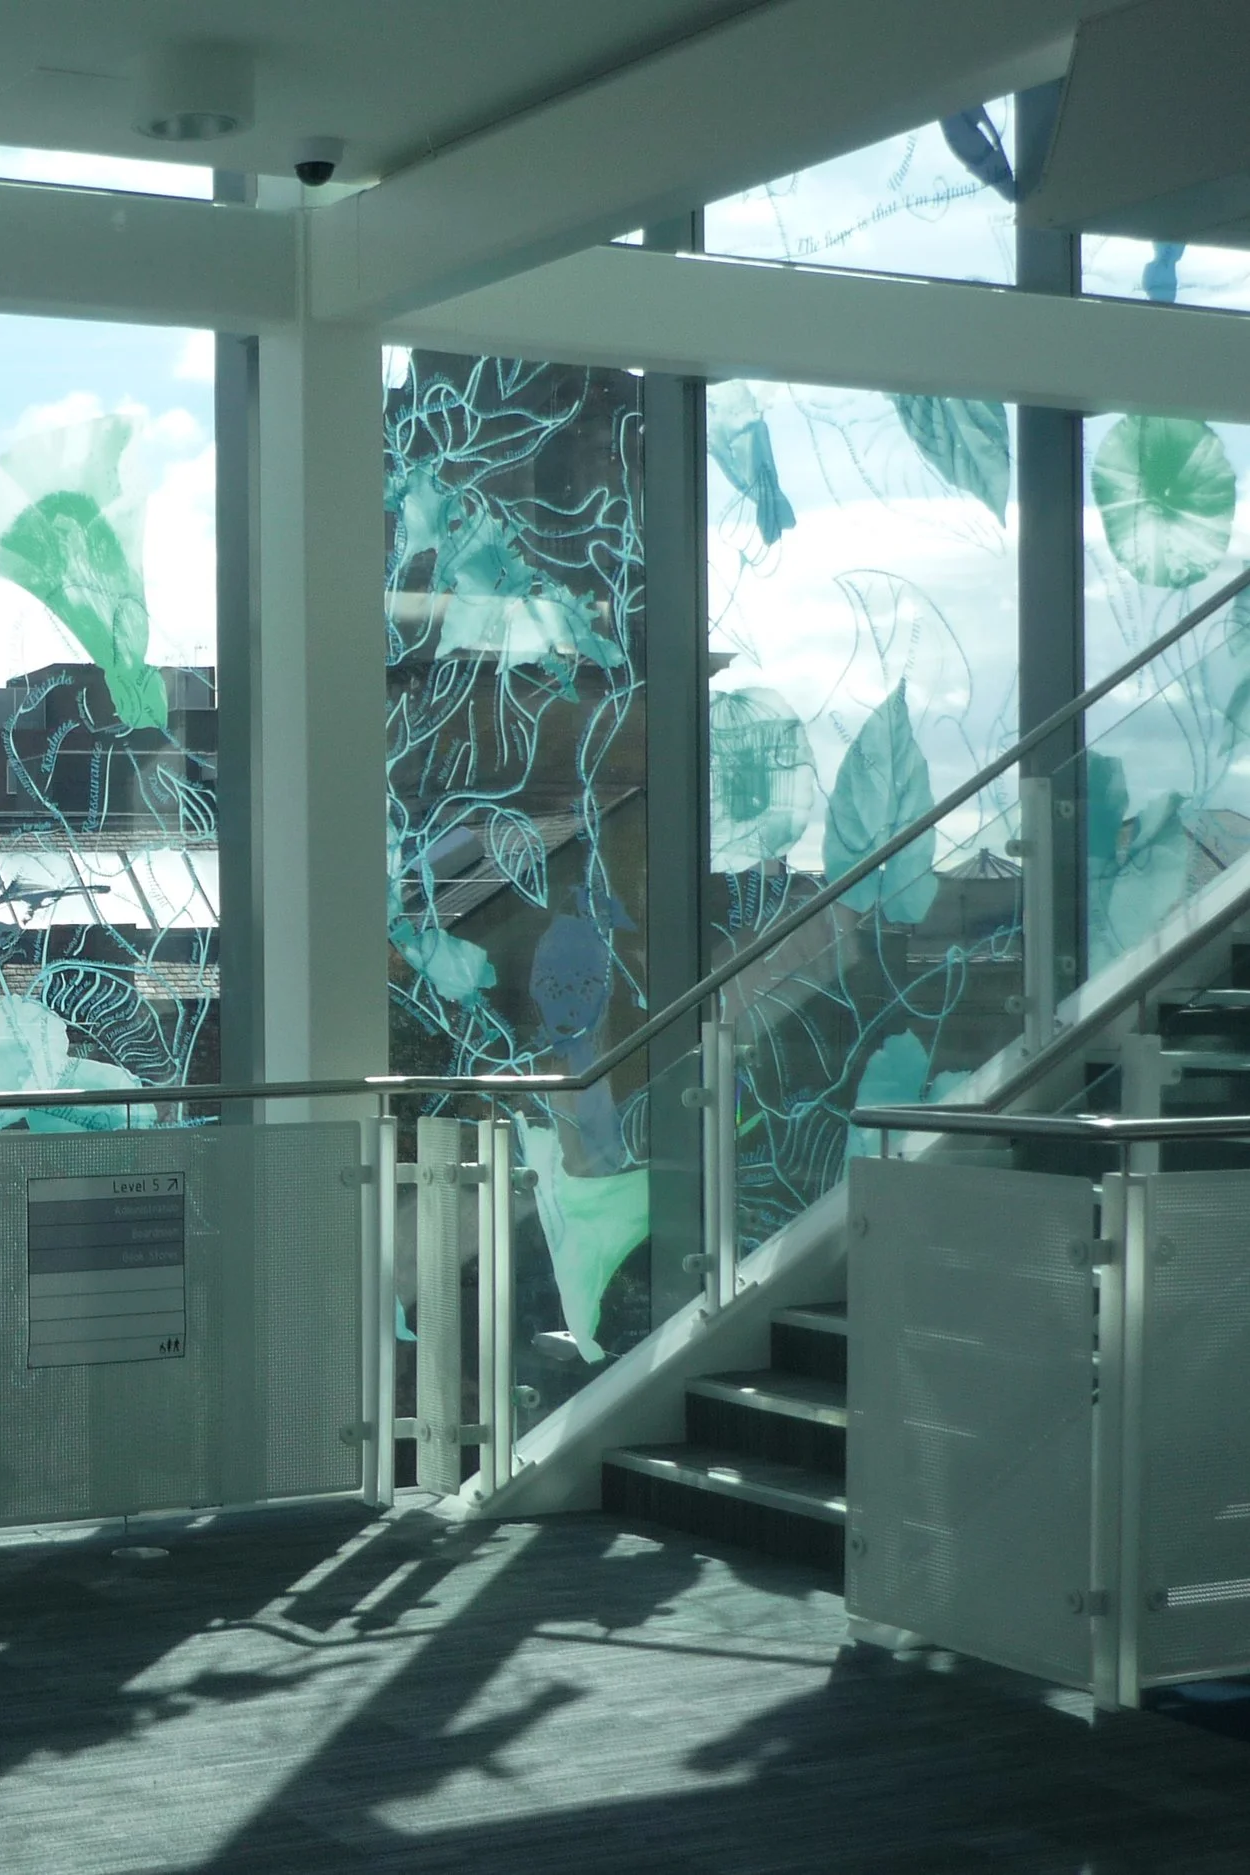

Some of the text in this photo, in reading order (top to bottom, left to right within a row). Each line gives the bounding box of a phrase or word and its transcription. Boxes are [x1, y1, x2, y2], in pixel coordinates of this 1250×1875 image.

[41, 719, 75, 774] Kindness
[82, 742, 103, 834] Reassurance
[113, 1178, 160, 1194] Level 5
